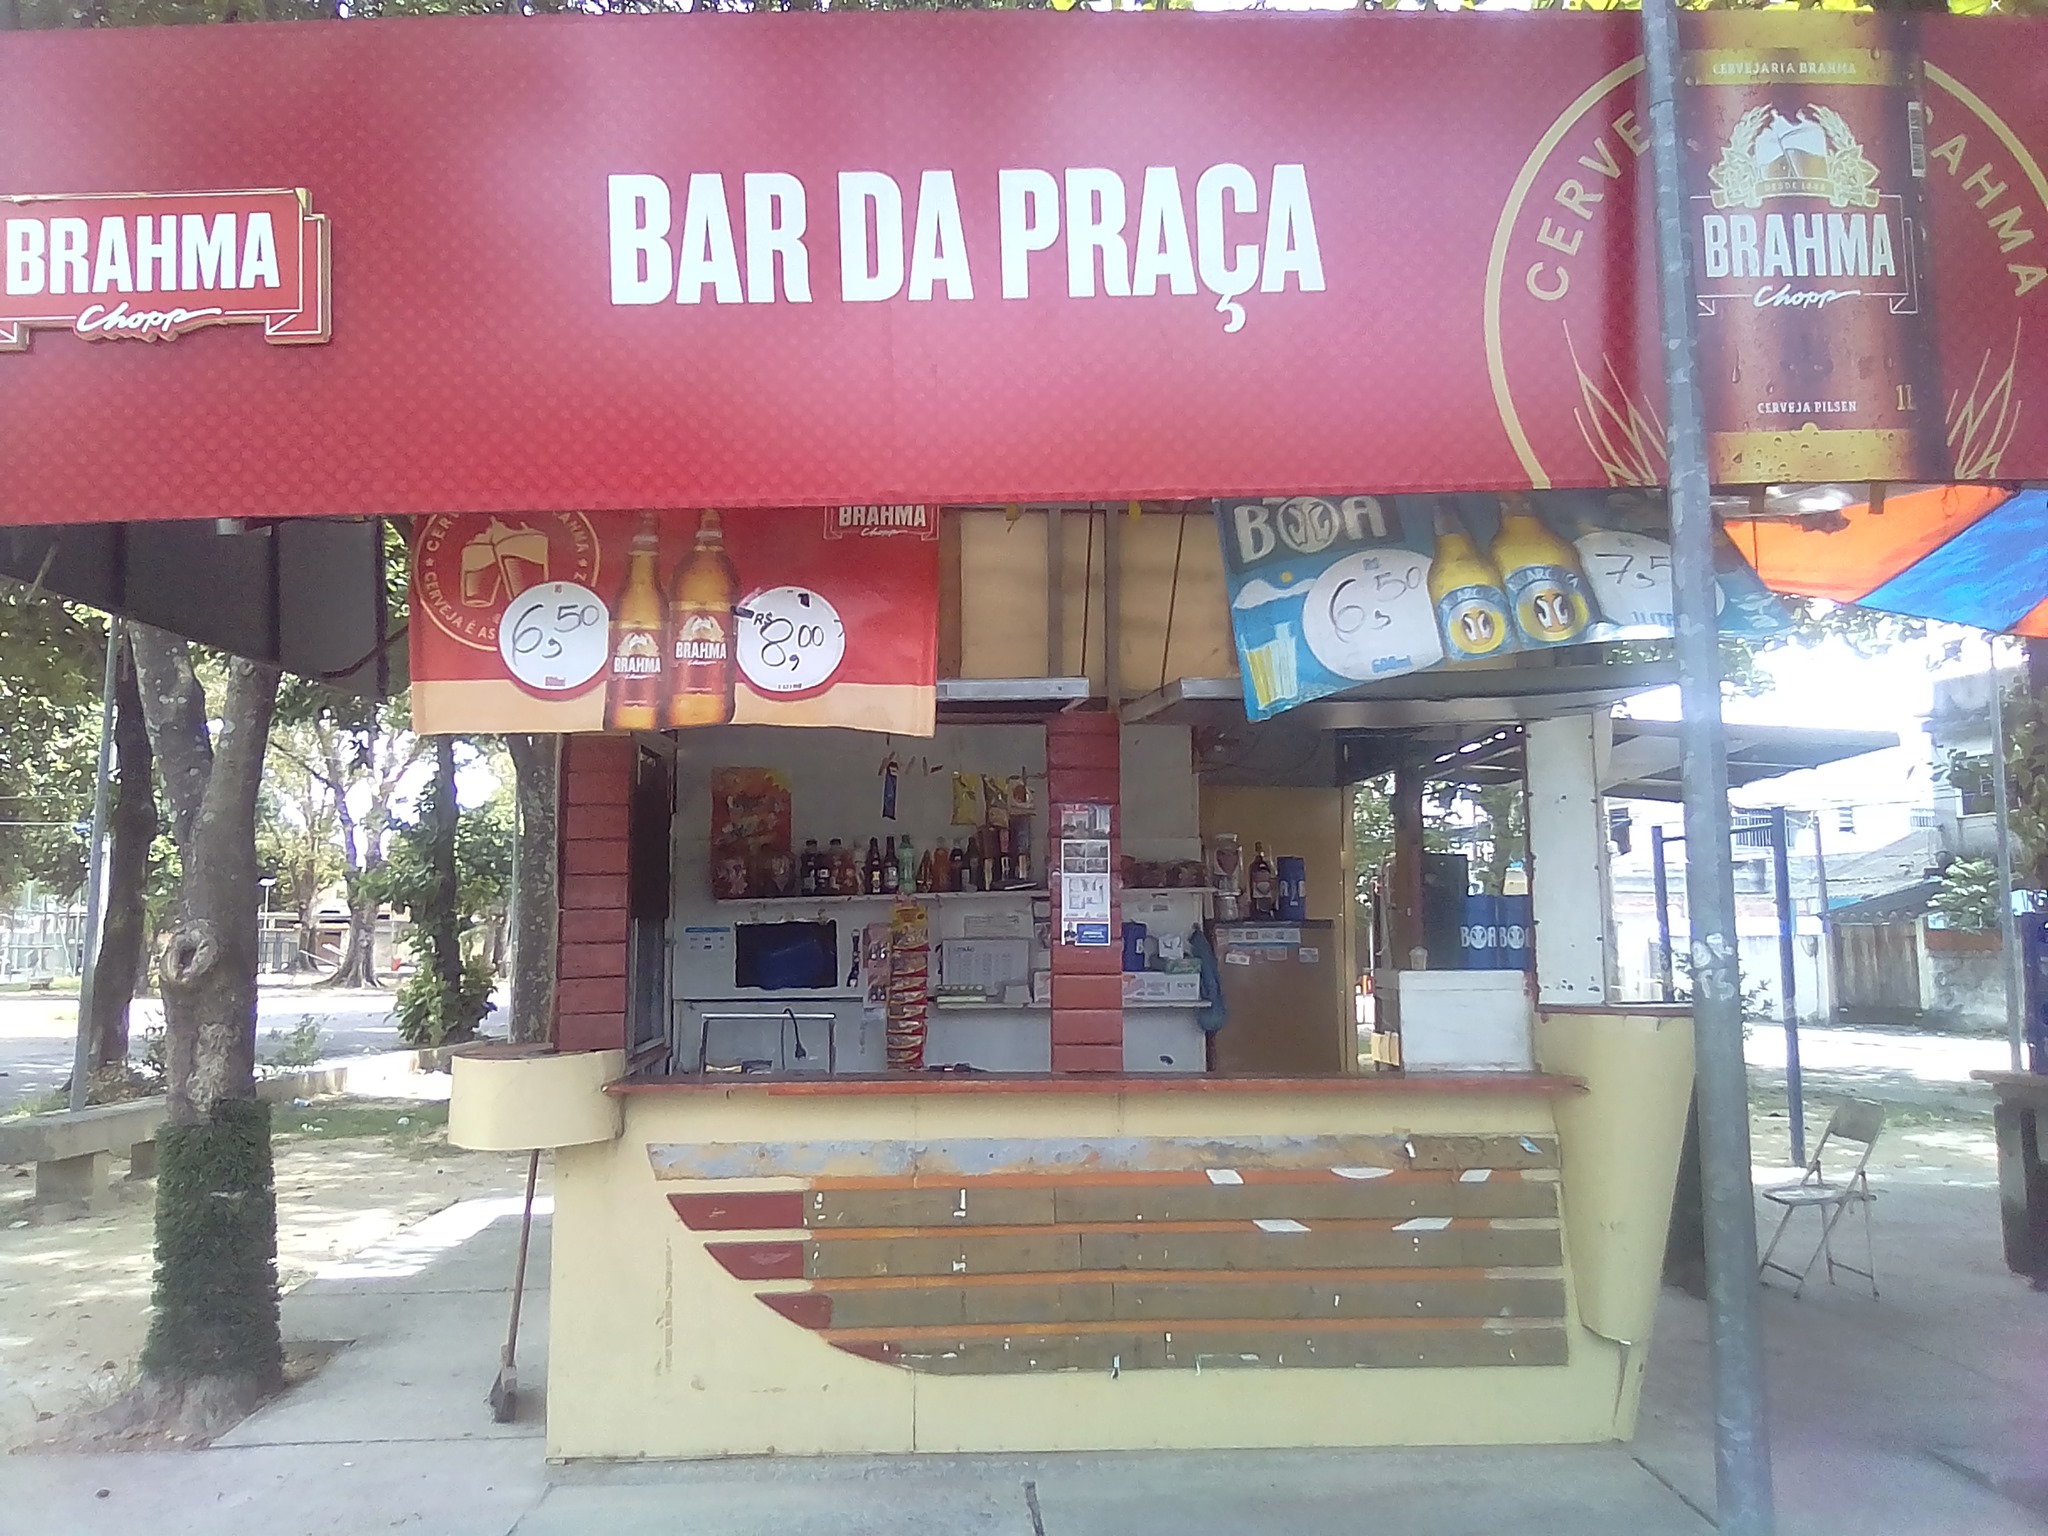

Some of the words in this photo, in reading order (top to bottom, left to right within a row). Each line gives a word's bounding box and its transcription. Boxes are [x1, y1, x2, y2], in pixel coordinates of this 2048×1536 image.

[1799, 61, 1856, 75] BRAHMA
[1526, 109, 1653, 301] CERVE
[1926, 105, 2048, 298] AHMA
[6, 211, 280, 296] BRAHMA
[607, 172, 813, 305] BAR
[837, 169, 975, 302] DA
[998, 162, 1326, 333] PRAÇA
[1703, 213, 1896, 278] BRAHMA
[76, 301, 223, 333] Chopp
[1752, 283, 1861, 309] Chopp
[1757, 401, 1811, 414] CERVEJA
[1814, 400, 1857, 413] PILSEN
[838, 504, 927, 527] BRAHMA
[1595, 553, 1673, 588] 7,5
[424, 571, 463, 629] CERVEJA
[753, 612, 773, 626] R$
[1328, 566, 1422, 644] 6,50
[512, 603, 601, 667] 6,50
[675, 641, 727, 660] BRAHMA
[759, 618, 825, 672] 8,00
[613, 656, 662, 673] BRAHMA
